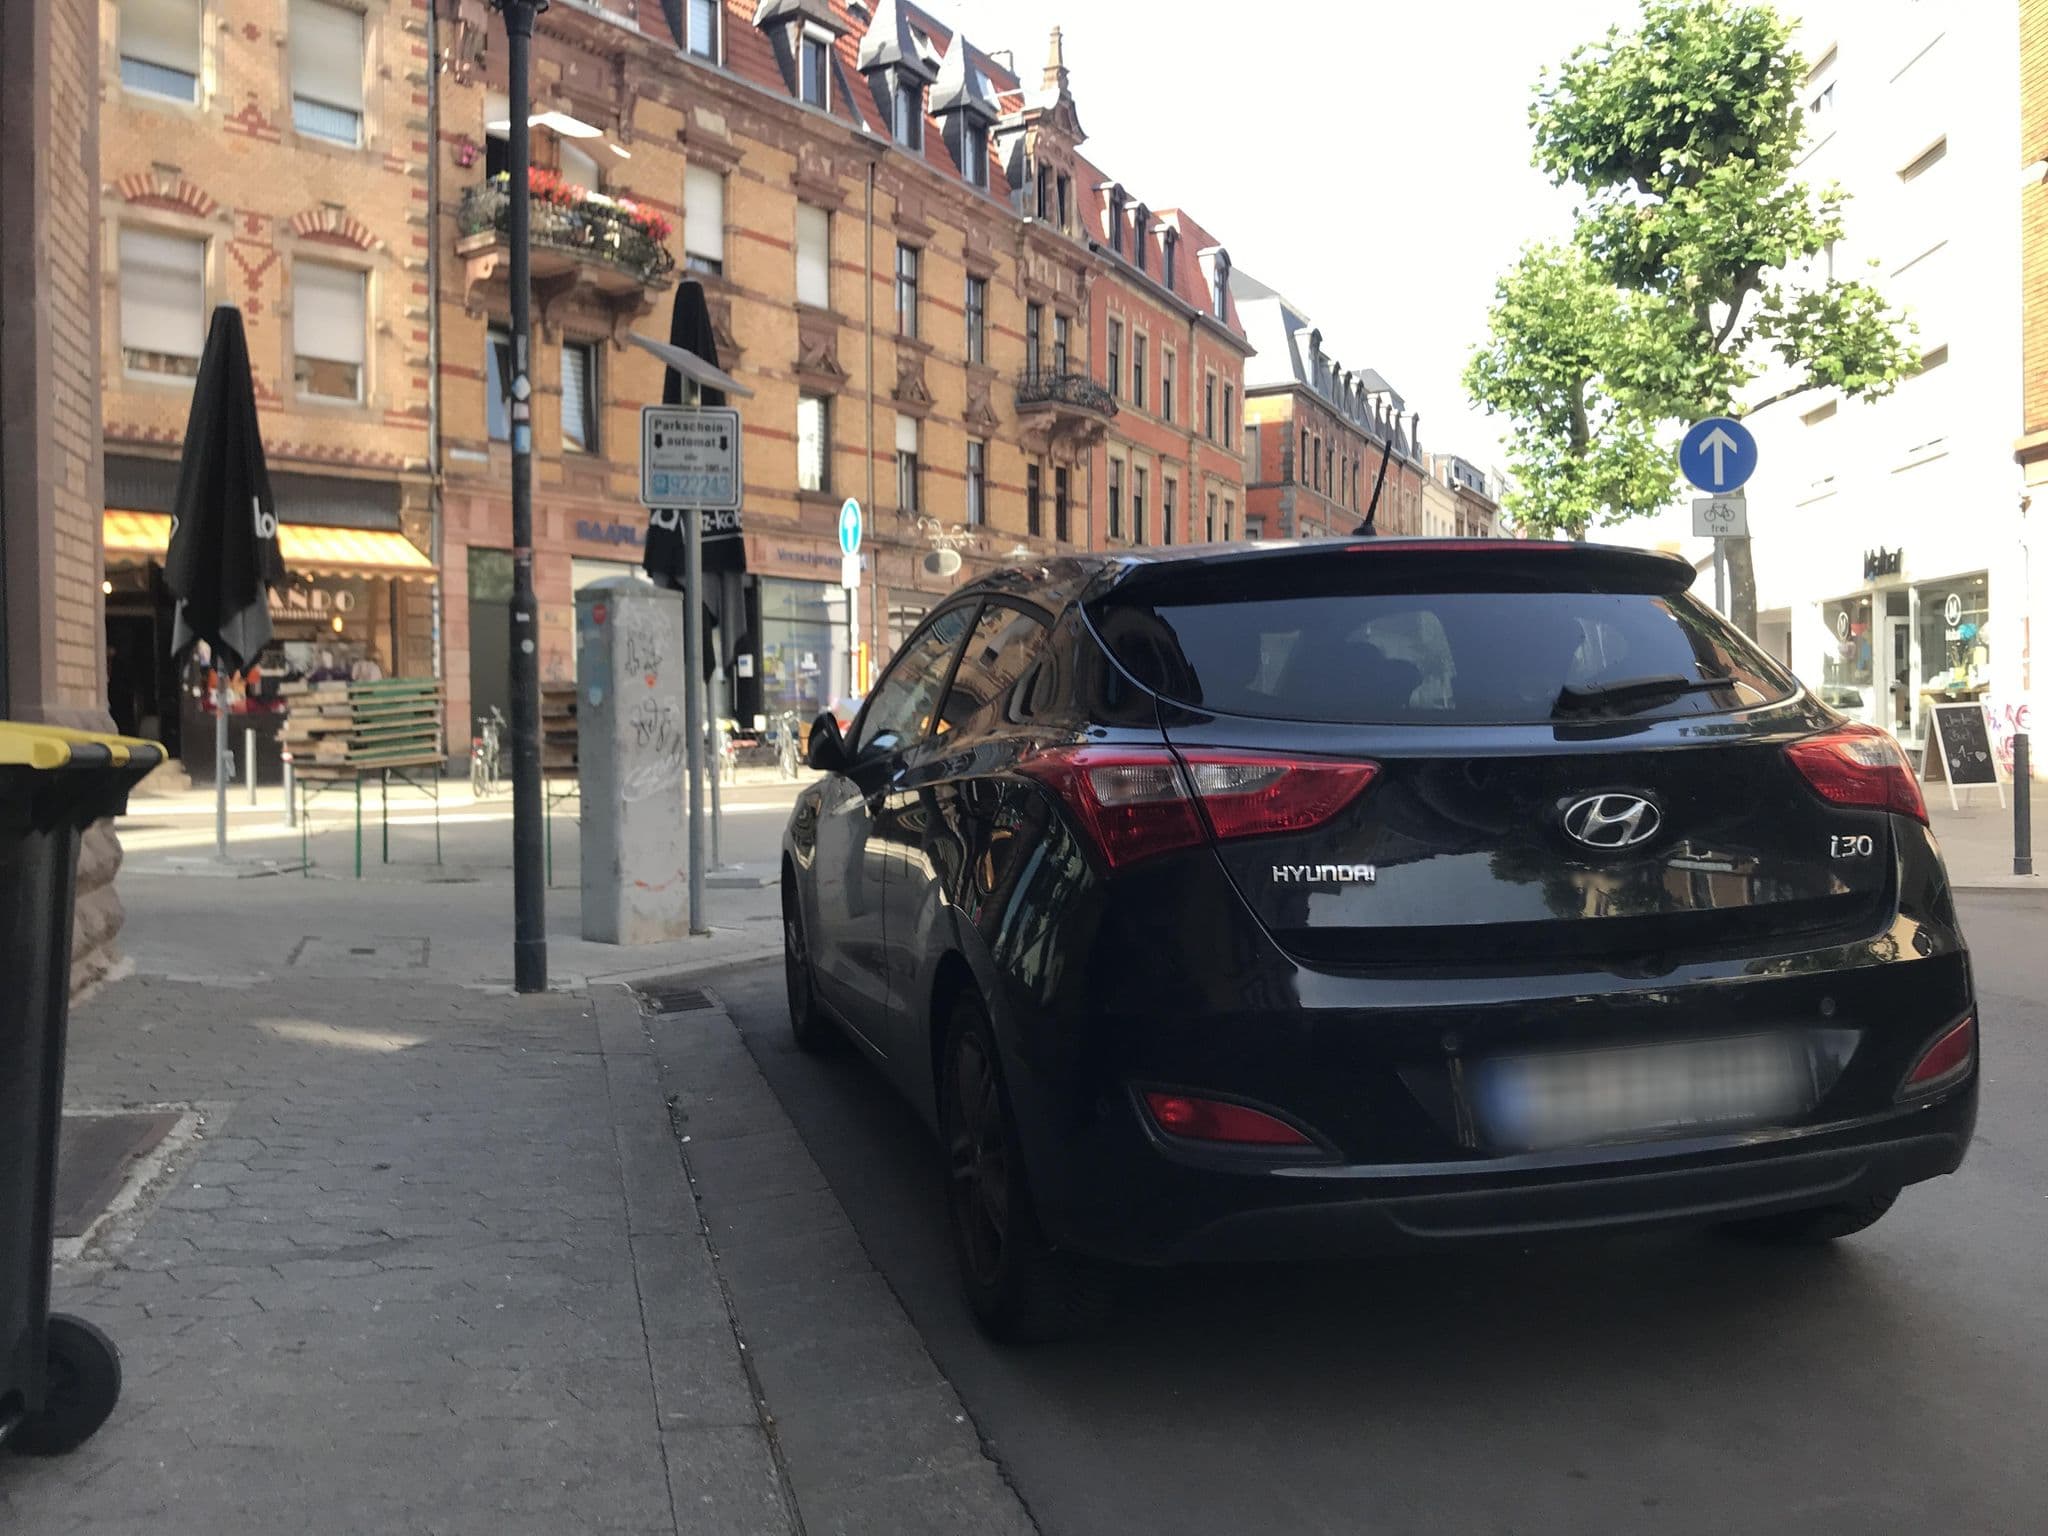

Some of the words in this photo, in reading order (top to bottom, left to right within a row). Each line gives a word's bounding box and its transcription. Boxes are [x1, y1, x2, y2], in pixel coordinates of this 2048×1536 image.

[666, 436, 716, 449] automat
[1711, 523, 1729, 533] frei
[1831, 834, 1873, 858] i30
[1272, 864, 1376, 882] HYUNDAI
